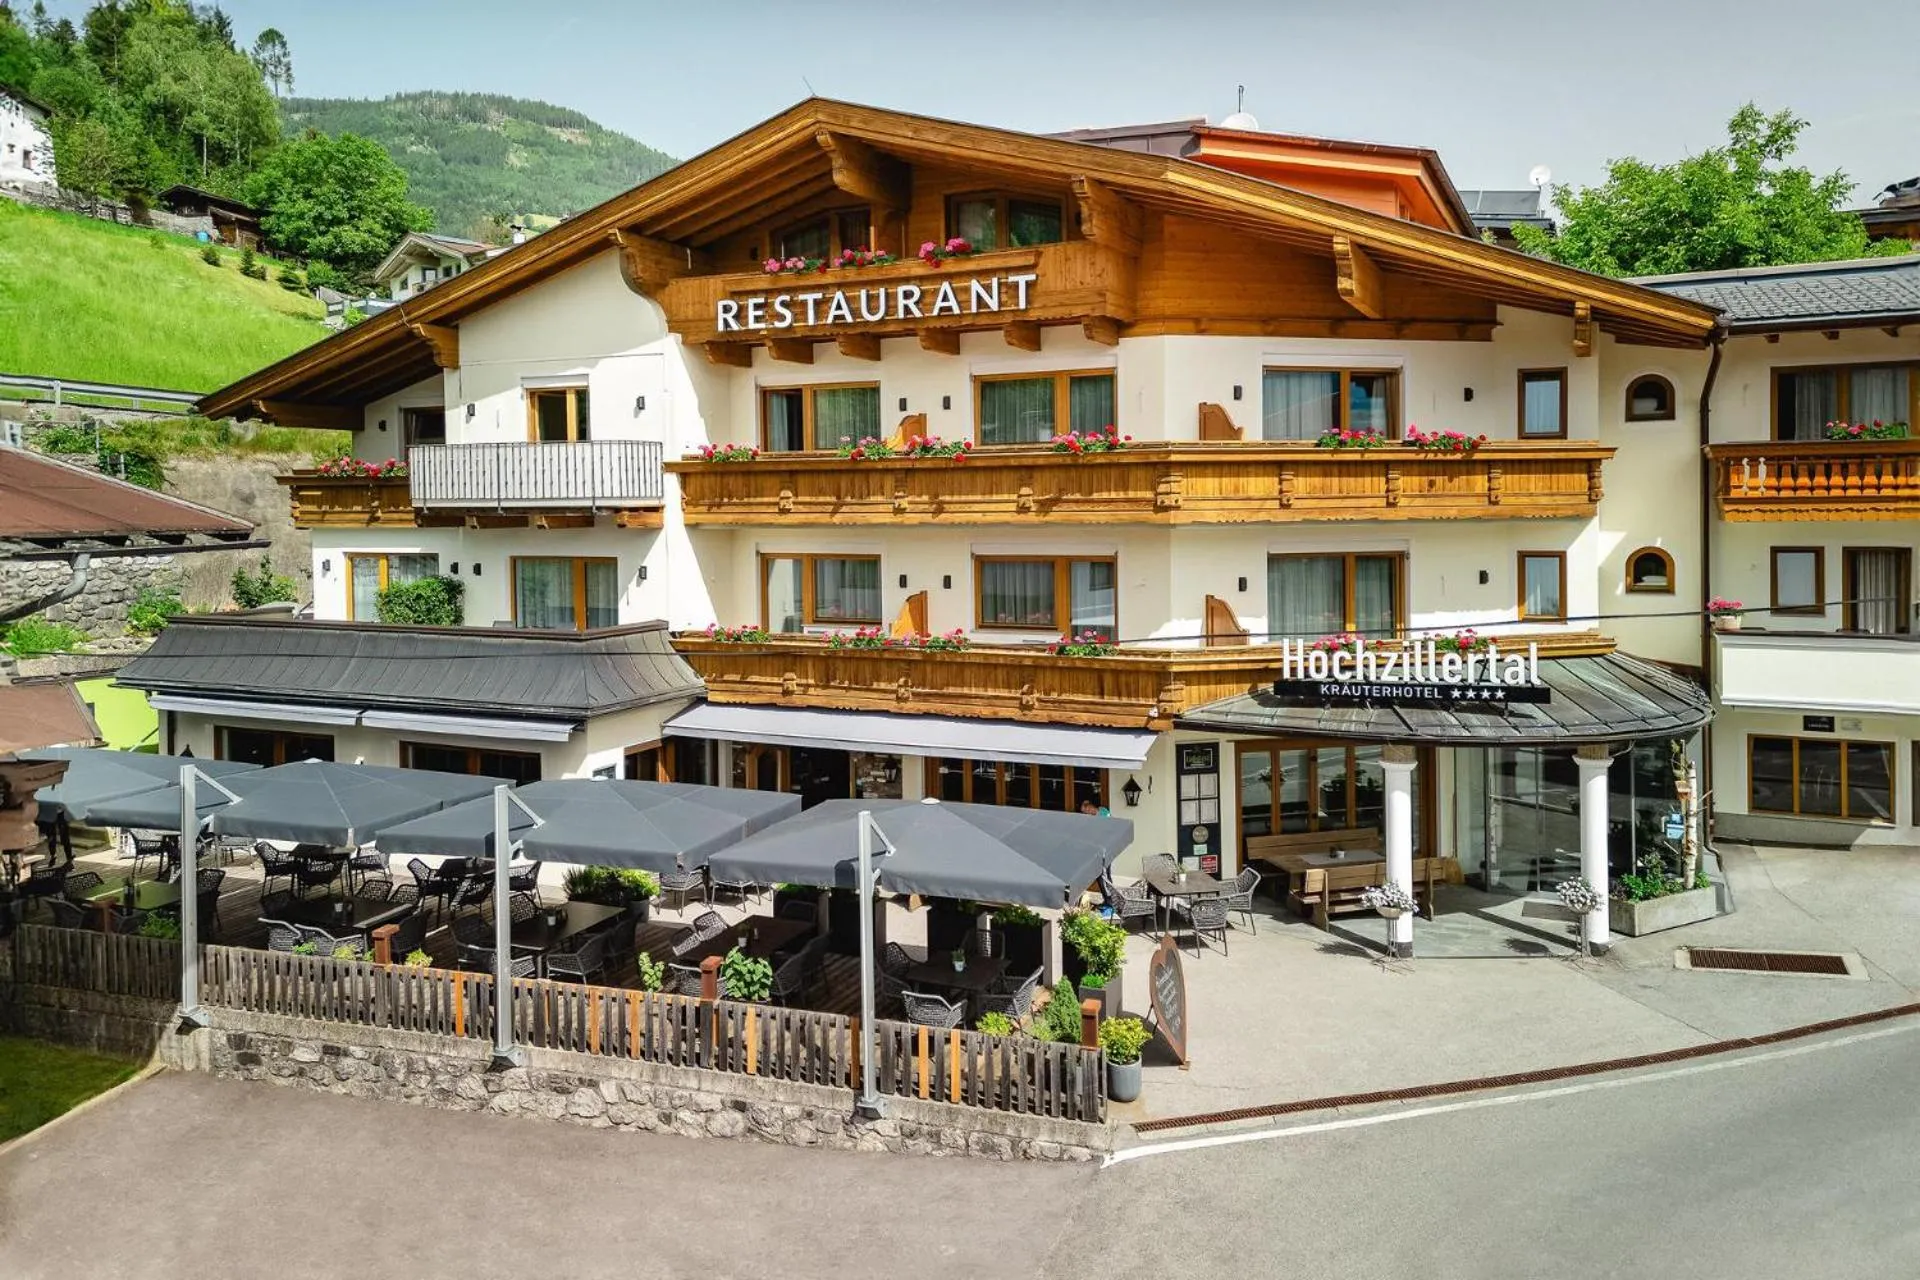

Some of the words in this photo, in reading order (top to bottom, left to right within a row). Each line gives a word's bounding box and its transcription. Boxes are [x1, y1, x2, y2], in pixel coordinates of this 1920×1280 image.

[717, 274, 1036, 331] RESTAURANT
[1282, 638, 1541, 685] Hochzillertal
[1320, 684, 1443, 699] KRÄUTERHOTEL
